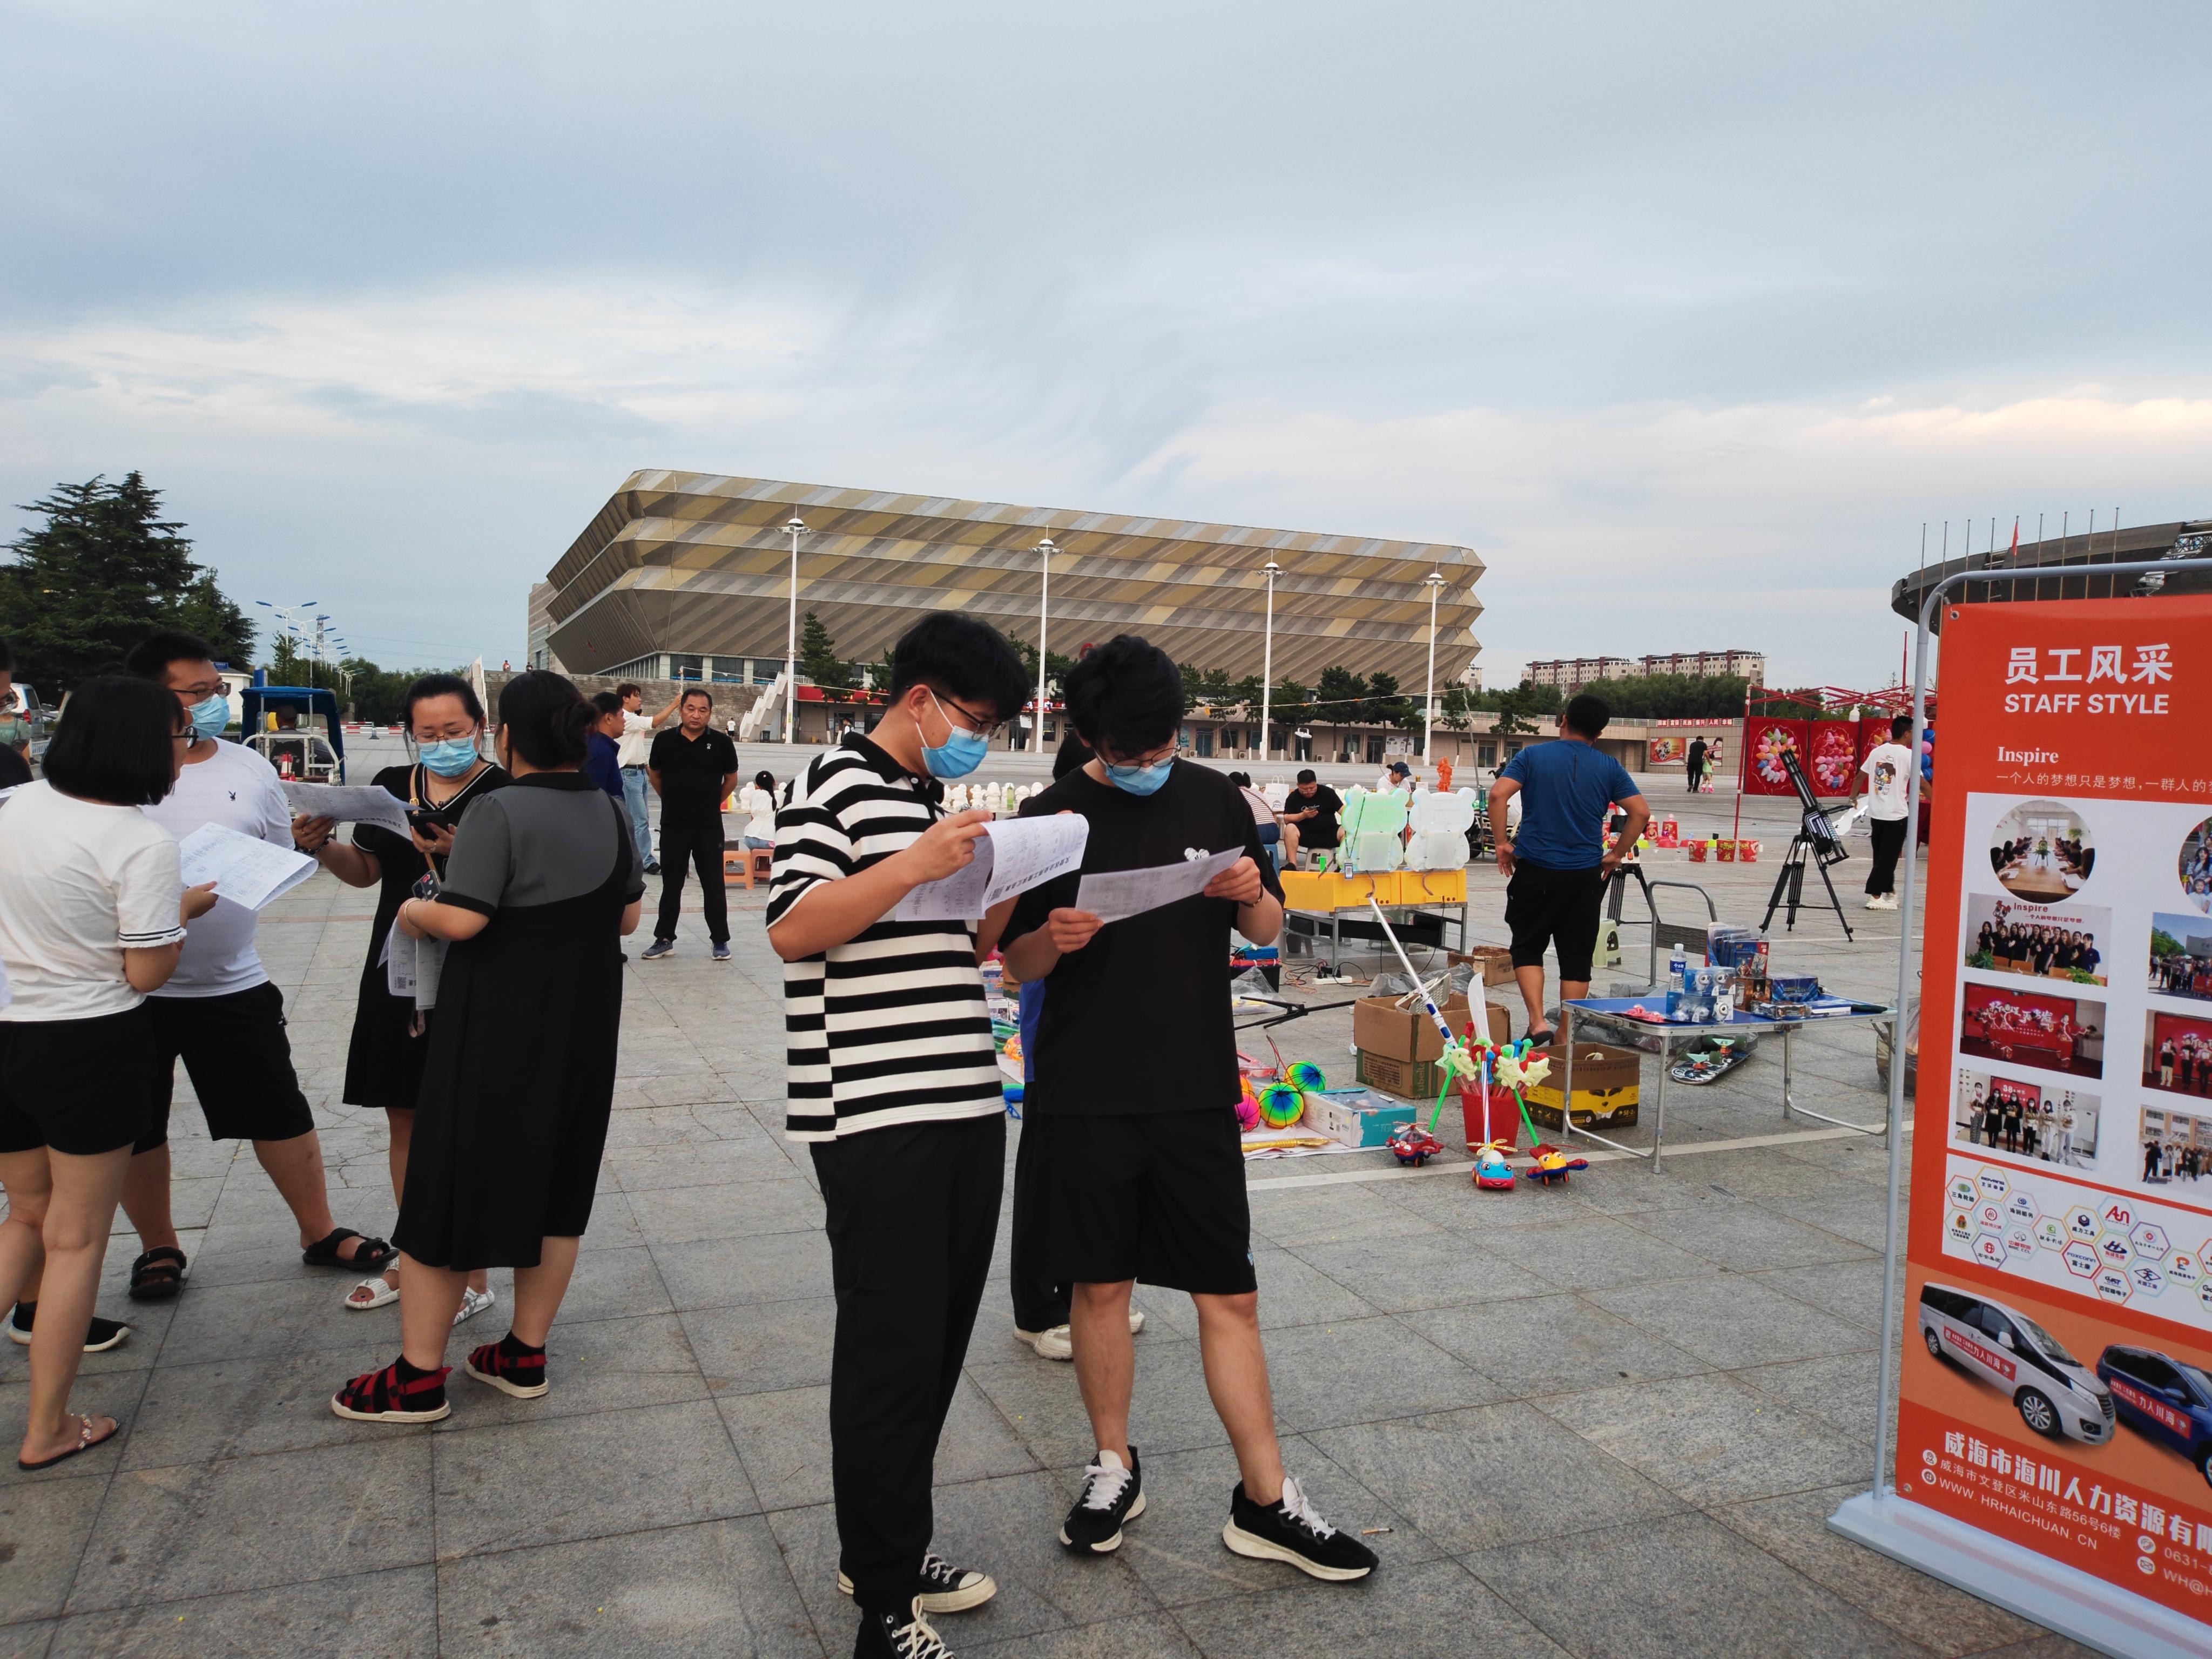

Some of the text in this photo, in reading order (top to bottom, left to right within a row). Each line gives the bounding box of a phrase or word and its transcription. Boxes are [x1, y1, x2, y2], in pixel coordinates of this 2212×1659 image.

[2005, 643, 2173, 685] 员工风采
[2004, 693, 2169, 714] STAFF STYLE
[1997, 746, 2059, 766] Inspire
[2014, 902, 2048, 913] Inspire
